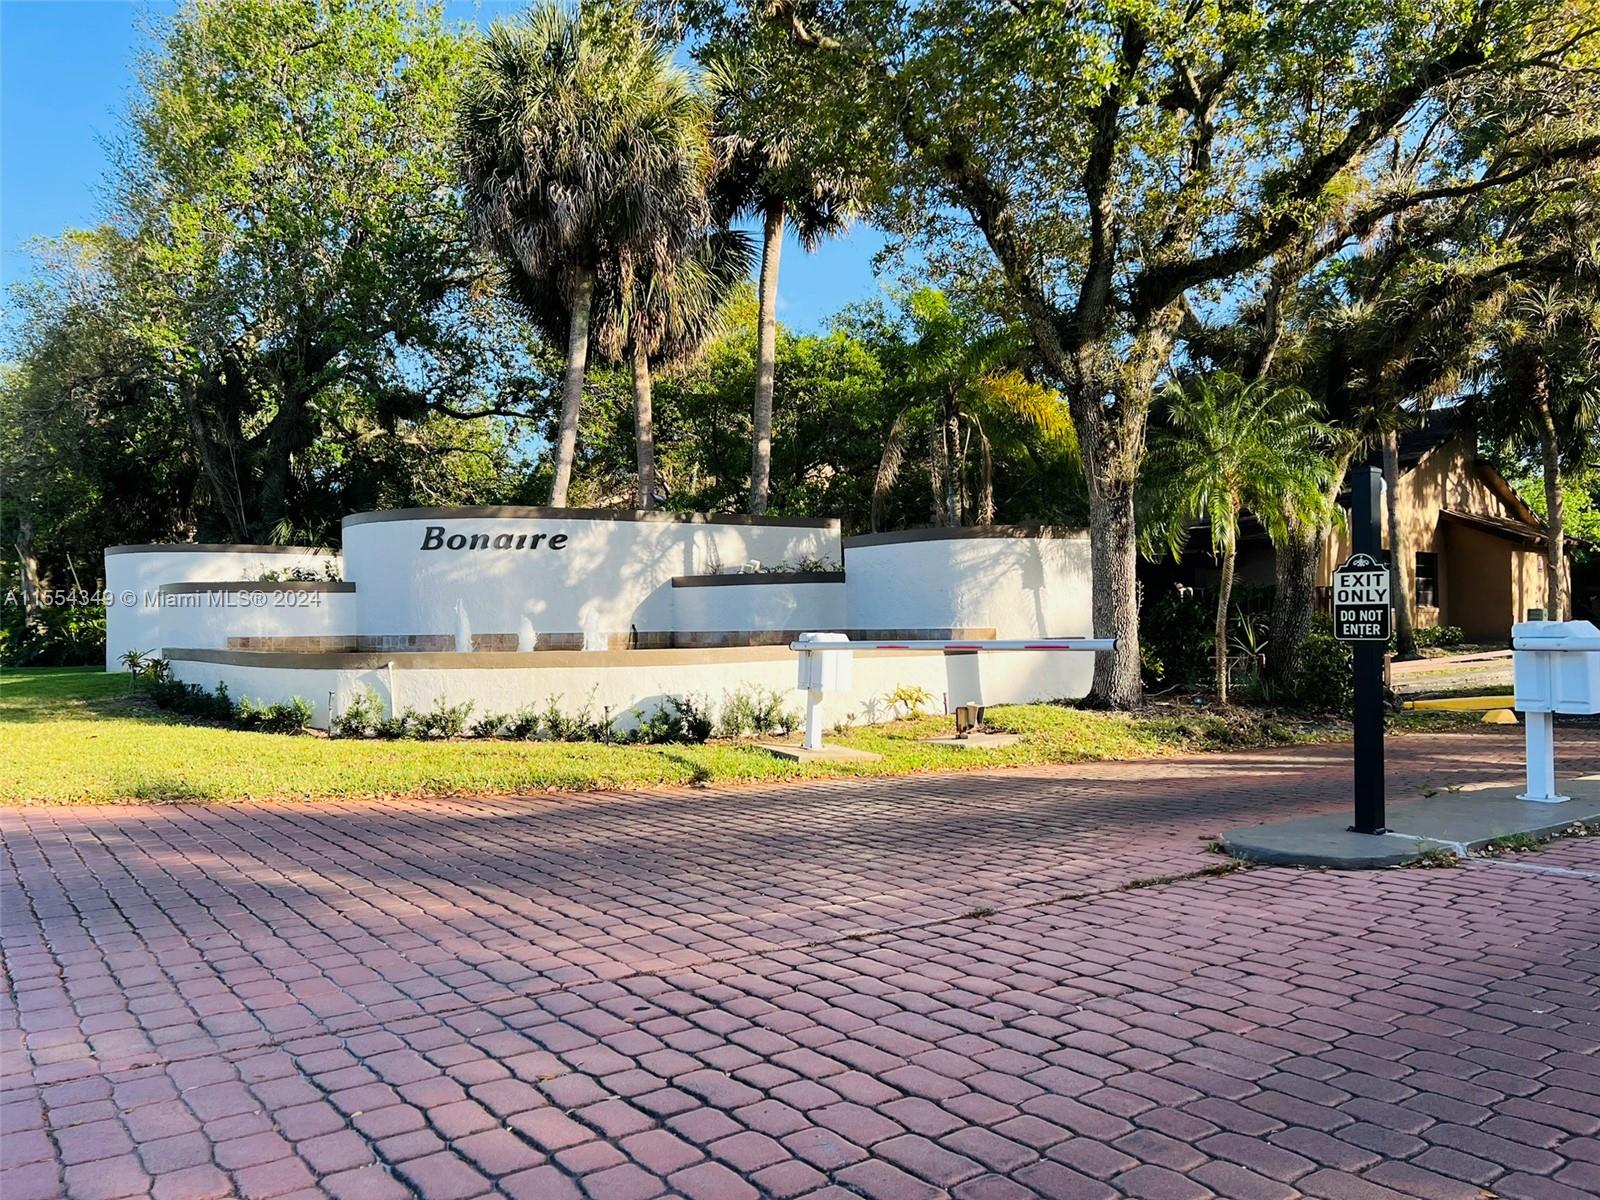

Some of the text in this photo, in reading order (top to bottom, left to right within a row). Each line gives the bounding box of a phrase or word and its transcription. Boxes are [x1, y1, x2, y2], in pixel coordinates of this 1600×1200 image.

[420, 526, 568, 551] Bonaire
[1341, 574, 1384, 587] EXIT
[1338, 589, 1387, 602] ONLY
[1340, 610, 1383, 622] DO NOT
[1343, 624, 1380, 635] ENTER
